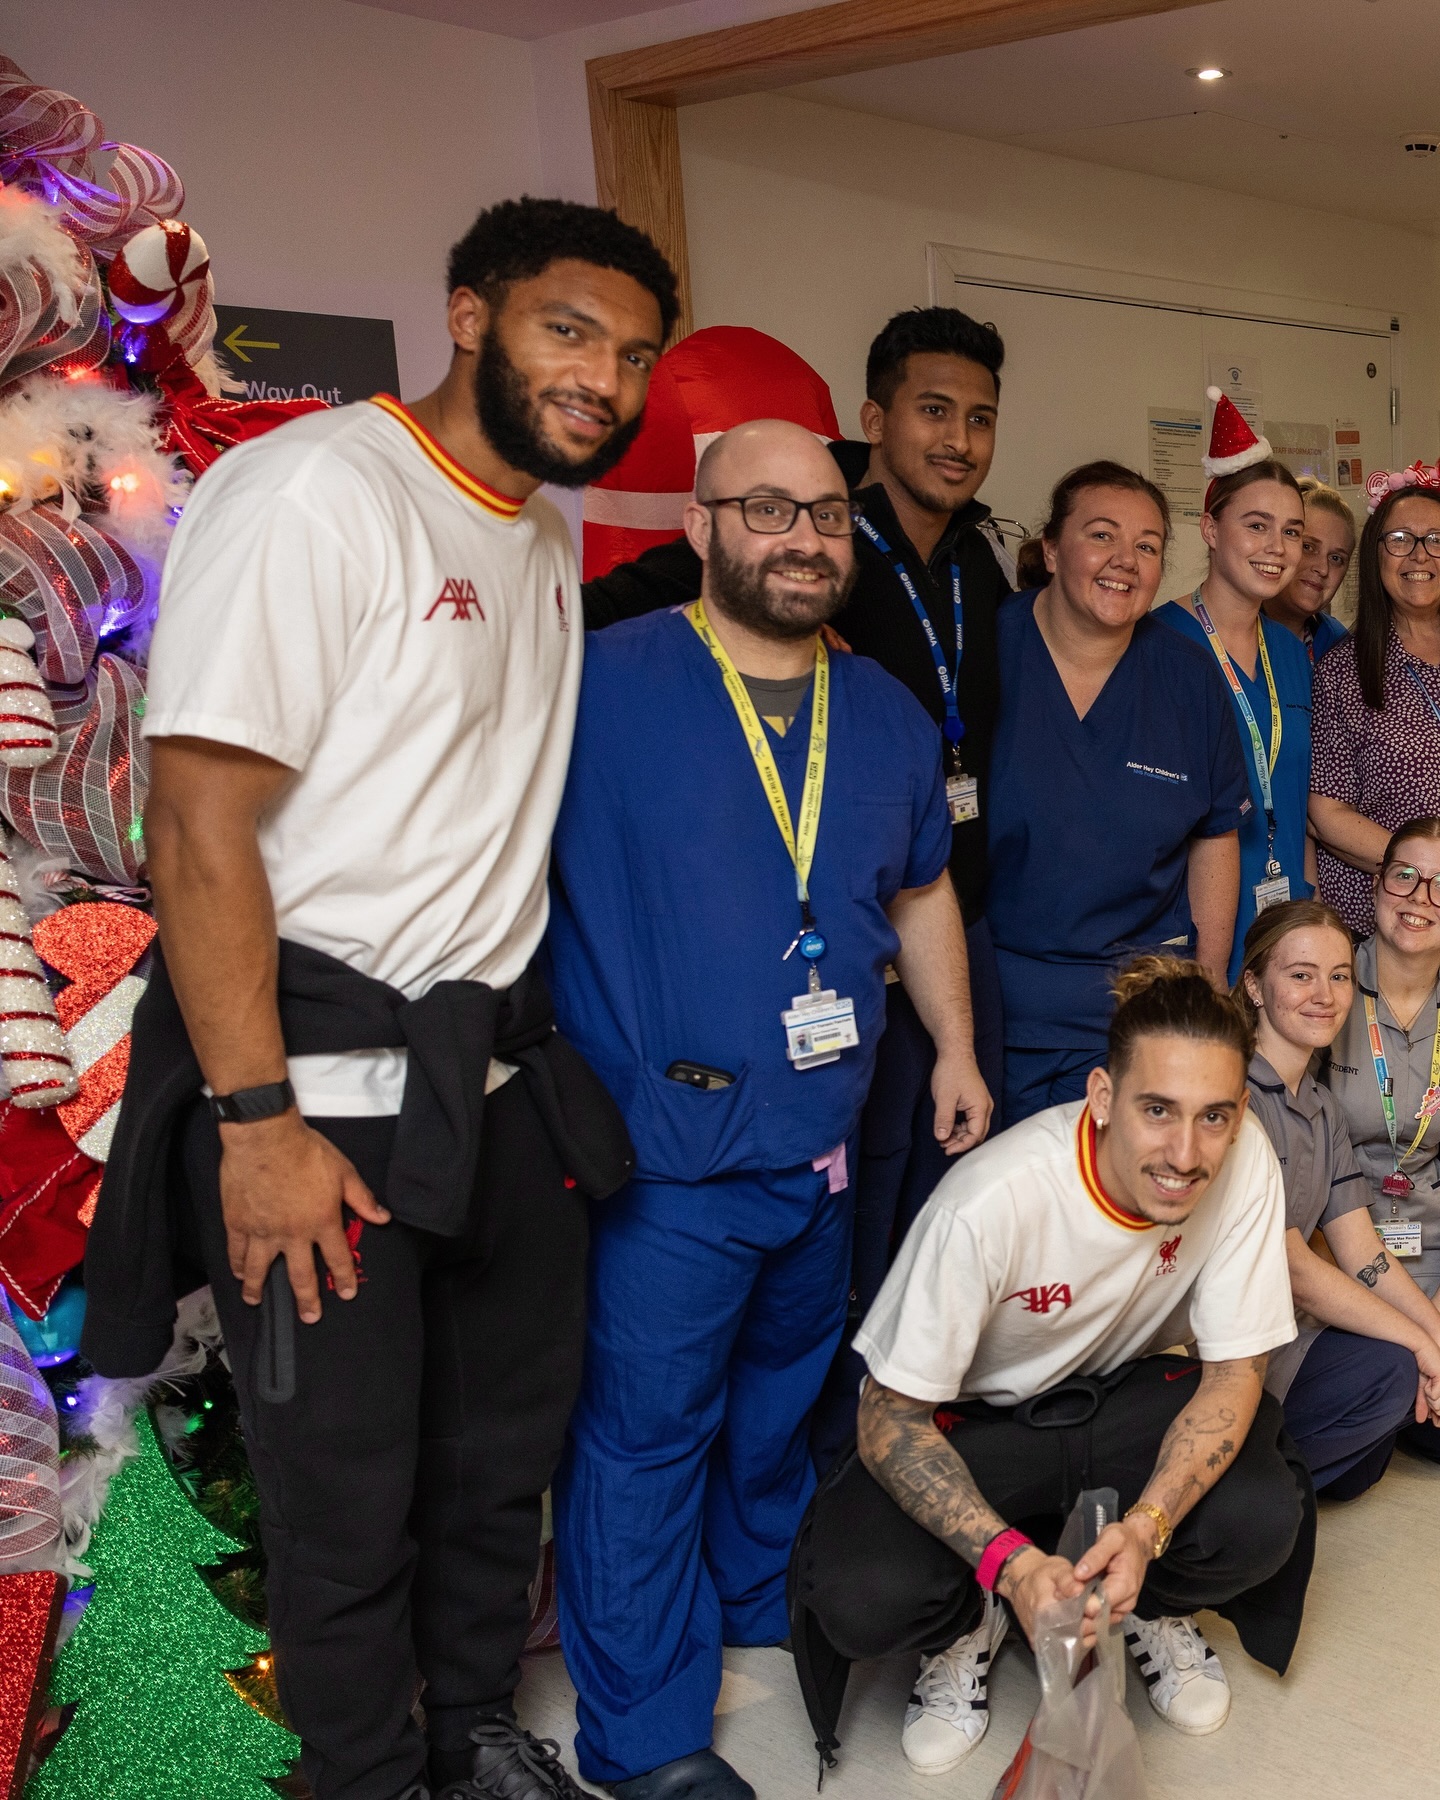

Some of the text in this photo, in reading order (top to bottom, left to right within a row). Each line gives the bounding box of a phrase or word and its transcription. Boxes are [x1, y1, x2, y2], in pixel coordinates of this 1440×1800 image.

[242, 380, 343, 404] Way Out
[1287, 447, 1322, 455] INFORMATION
[423, 578, 486, 622] AXA
[925, 627, 937, 647] BMA
[940, 674, 951, 694] BMA
[763, 765, 779, 794] CHILDREN
[1126, 761, 1143, 770] Alder
[1143, 764, 1155, 774] Hey
[1155, 767, 1180, 780] Children's
[806, 782, 816, 808] Children's
[777, 805, 792, 832] INSPIRED
[1155, 1265, 1177, 1276] LFC
[1000, 1282, 1072, 1313] AXA
